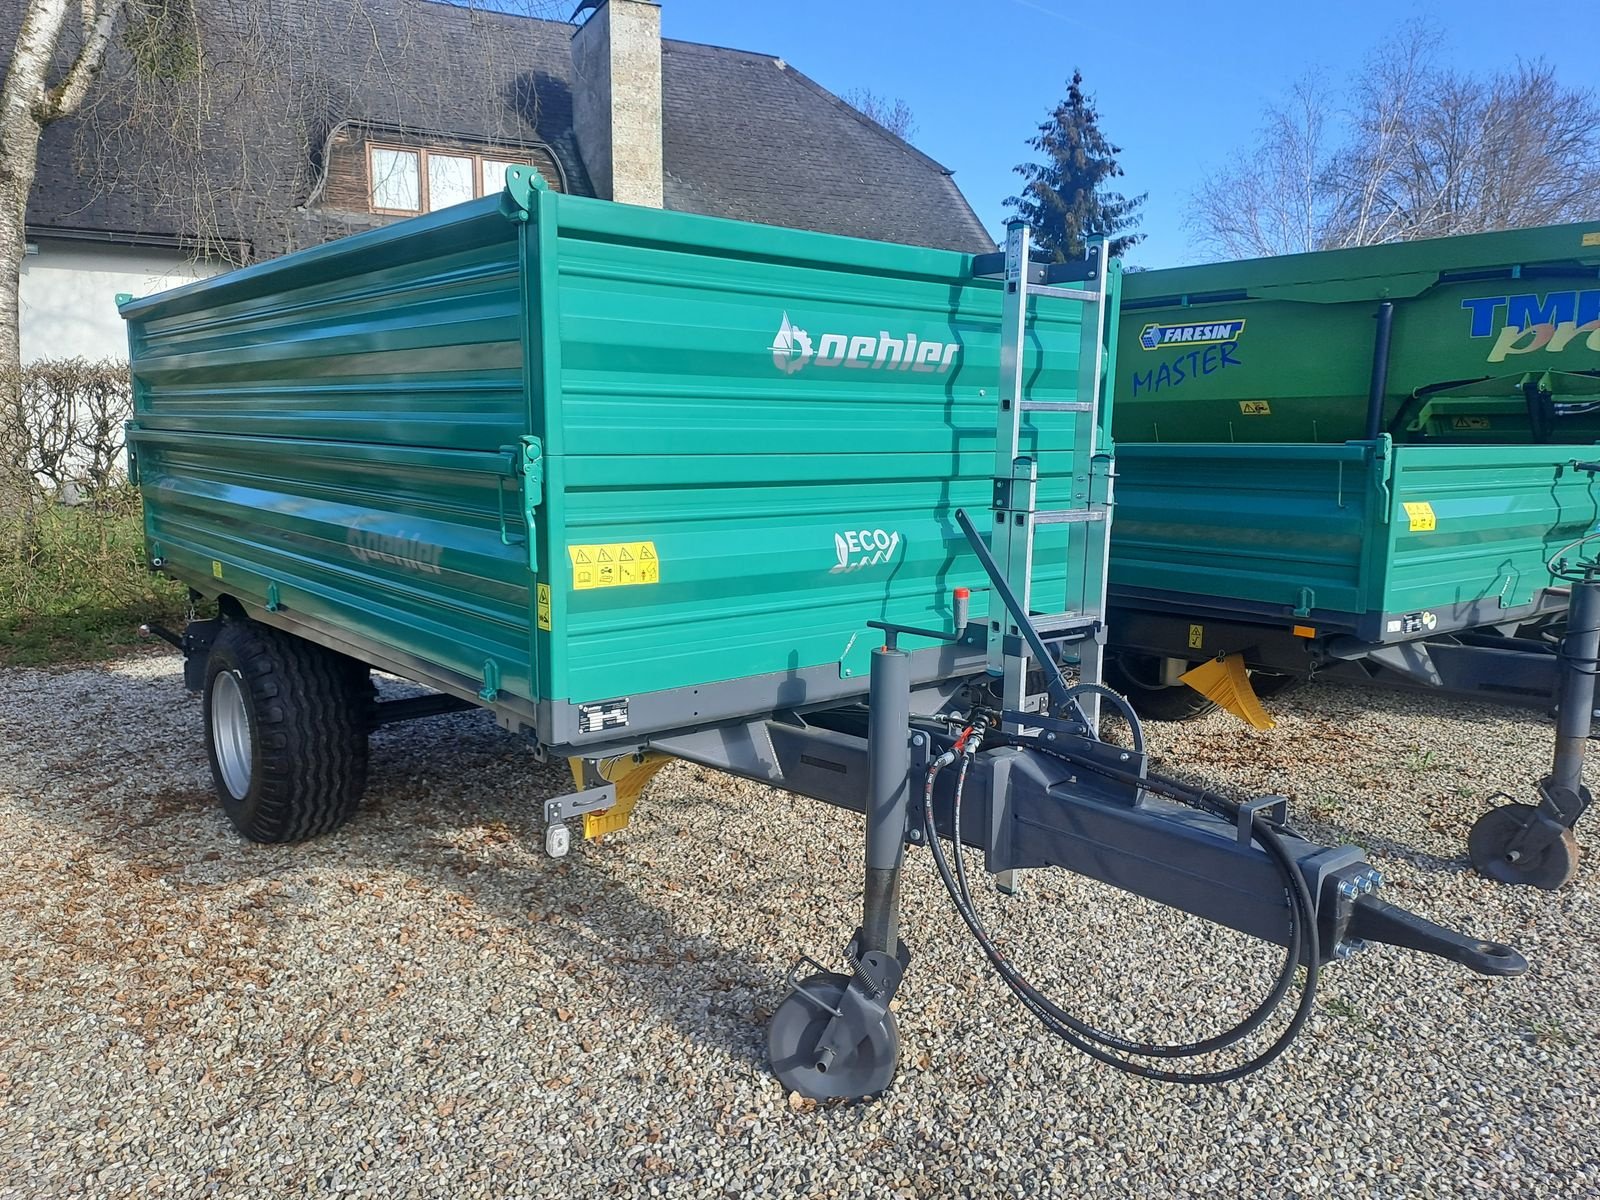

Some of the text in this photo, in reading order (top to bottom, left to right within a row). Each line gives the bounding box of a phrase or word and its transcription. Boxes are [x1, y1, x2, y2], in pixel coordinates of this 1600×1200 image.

[1164, 324, 1232, 342] FARESIN
[814, 330, 960, 373] oehler
[1133, 342, 1242, 397] MASTER
[844, 529, 890, 553] ECO
